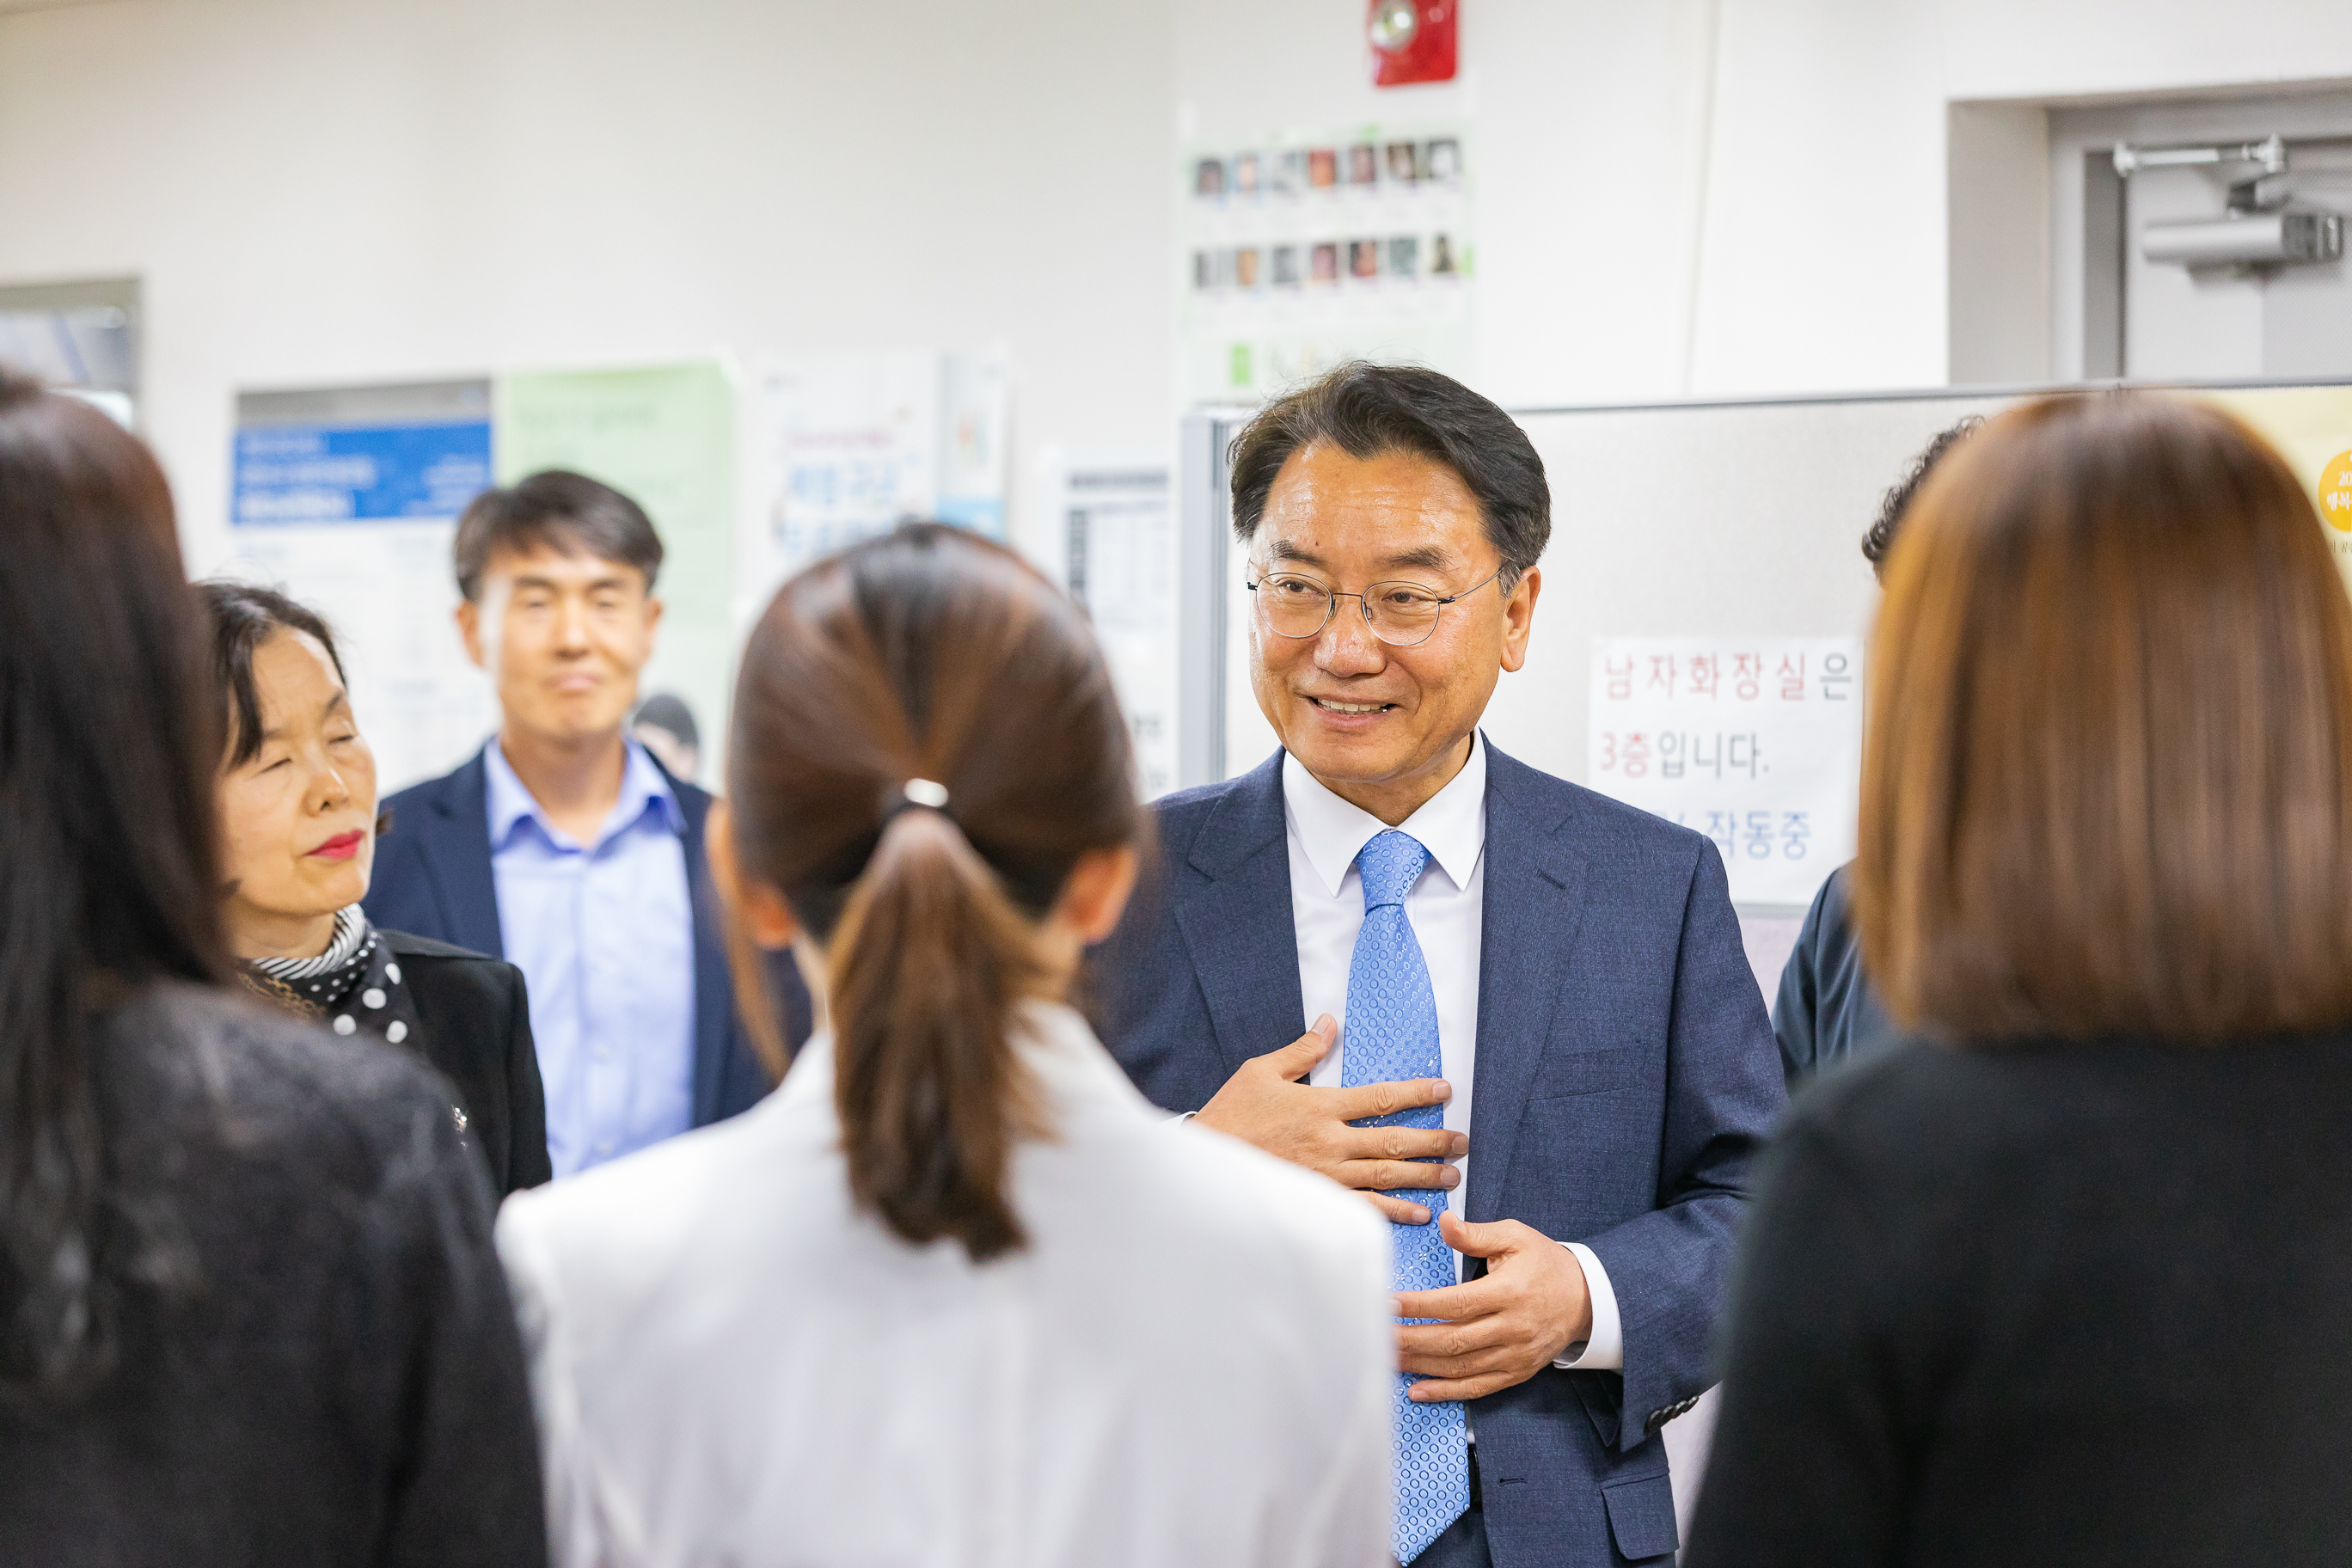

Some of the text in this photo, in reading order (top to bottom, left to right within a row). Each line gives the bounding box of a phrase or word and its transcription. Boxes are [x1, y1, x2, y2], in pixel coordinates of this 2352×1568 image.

[1605, 652, 1853, 701] 남자화장실은
[1601, 730, 1770, 781] 3층입니다.
[1706, 810, 1811, 861] 작동중
